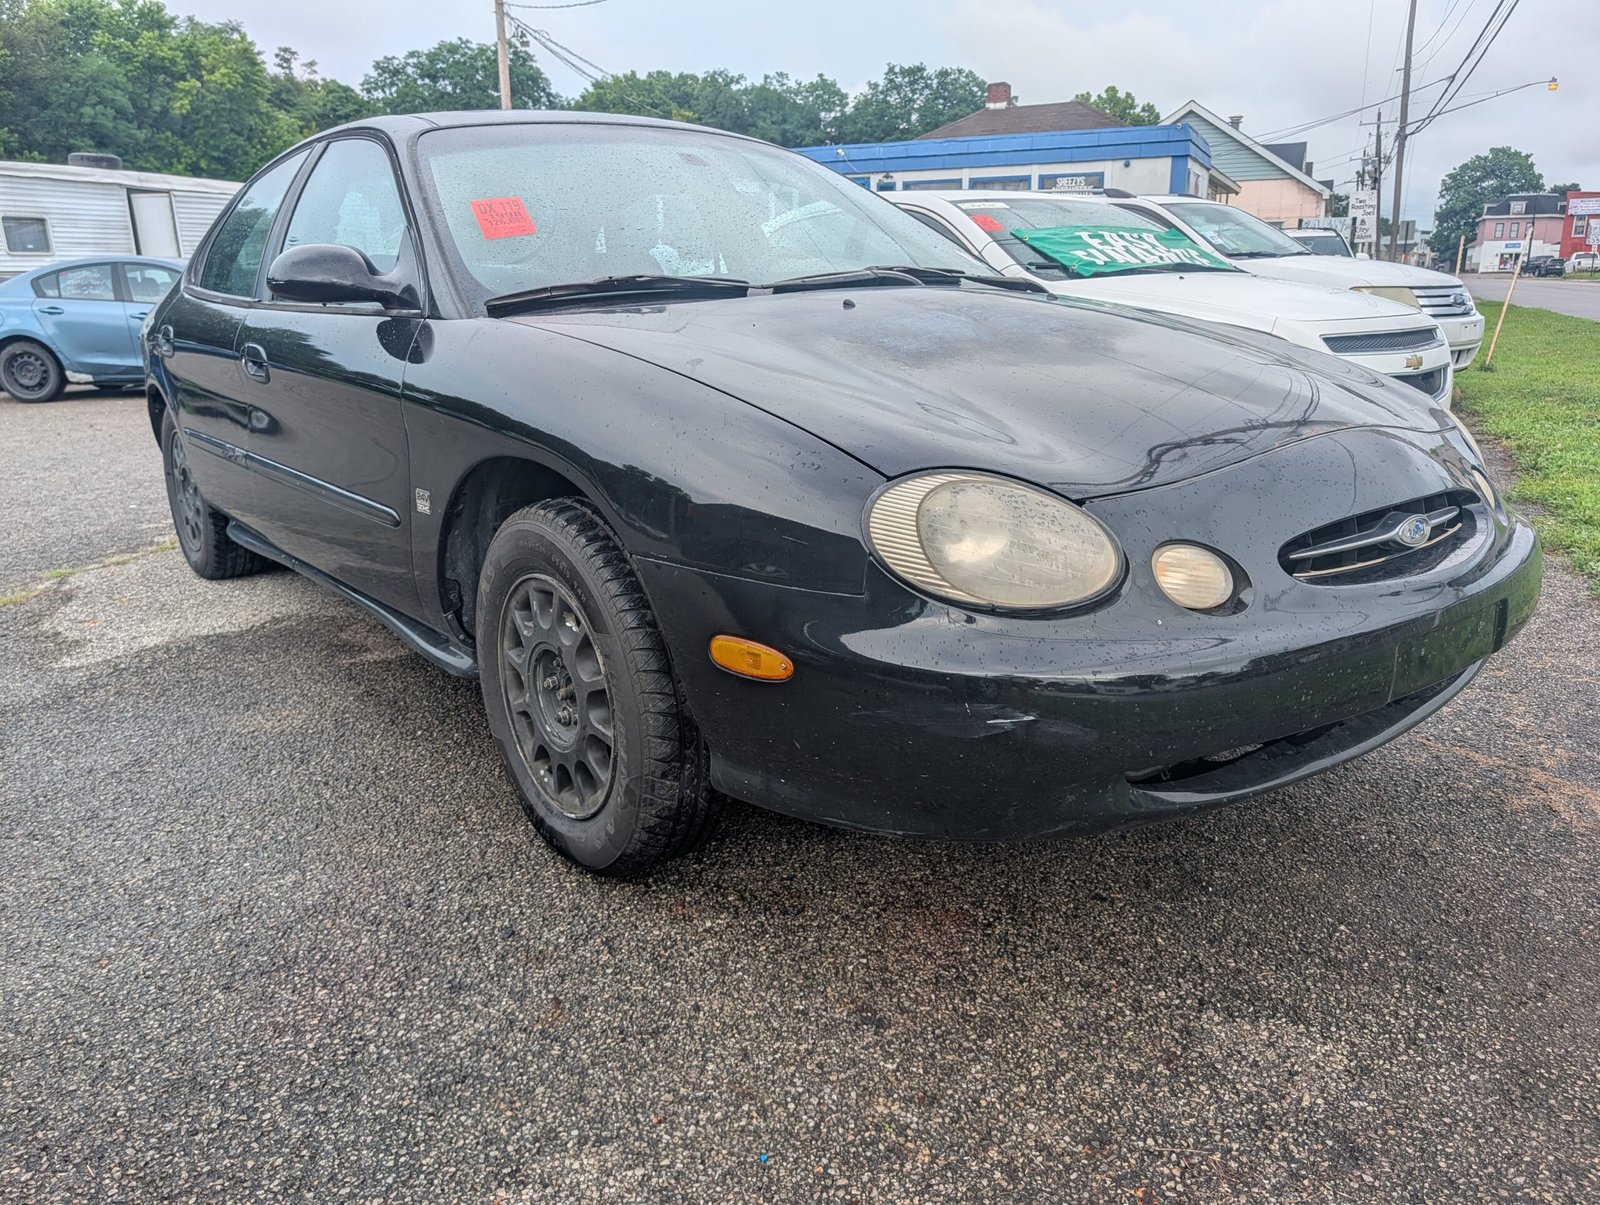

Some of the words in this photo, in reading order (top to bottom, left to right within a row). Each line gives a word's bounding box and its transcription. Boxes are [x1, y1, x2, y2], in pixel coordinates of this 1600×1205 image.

[498, 200, 521, 212] 119
[1354, 197, 1367, 205] Two
[1075, 231, 1170, 252] EASY
